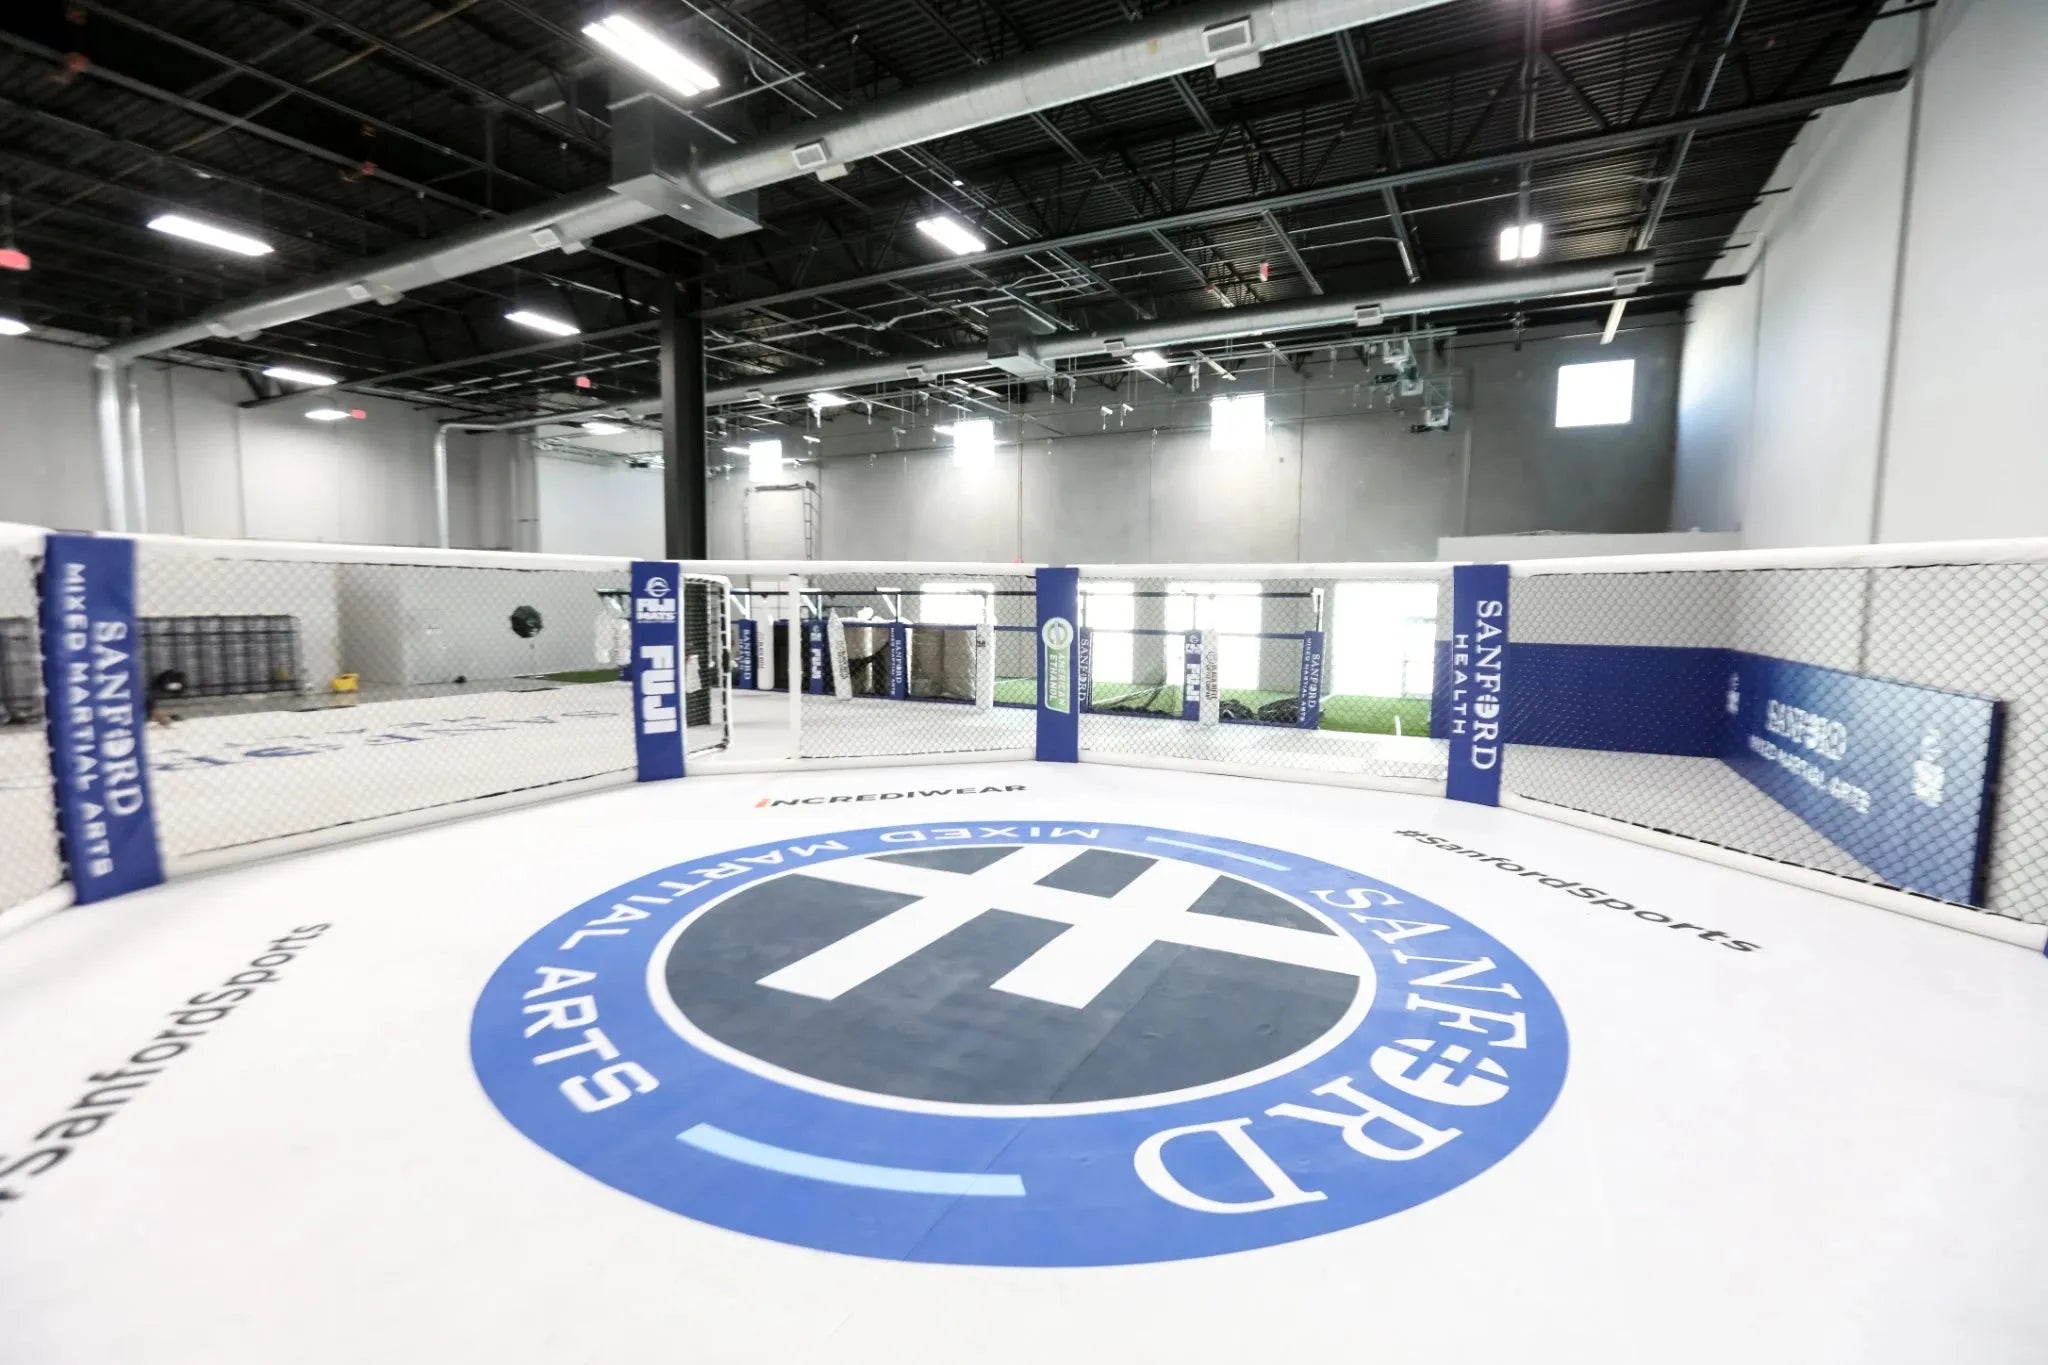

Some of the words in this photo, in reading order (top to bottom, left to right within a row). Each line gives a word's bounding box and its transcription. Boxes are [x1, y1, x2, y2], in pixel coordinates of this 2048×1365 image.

[63, 562, 88, 652] MIXED
[641, 645, 677, 735] FUJI
[811, 648, 822, 679] FUJI
[1049, 654, 1057, 701] ETHANOL
[1058, 653, 1066, 706] AMERICAN
[1080, 639, 1090, 701] SANFORD
[1185, 663, 1201, 702] FUJI
[1308, 653, 1321, 708] SANFORD
[1453, 634, 1468, 735] HEALTH
[1470, 600, 1503, 770] SANFORD
[68, 662, 100, 792] MARTIAL
[94, 620, 145, 817] SANFORD
[80, 802, 115, 878] ARTS
[880, 826, 1102, 844] MIXED
[559, 839, 852, 950] MARTIAL
[522, 965, 661, 1114] ARTS
[1133, 886, 1528, 1215] SANFORD
